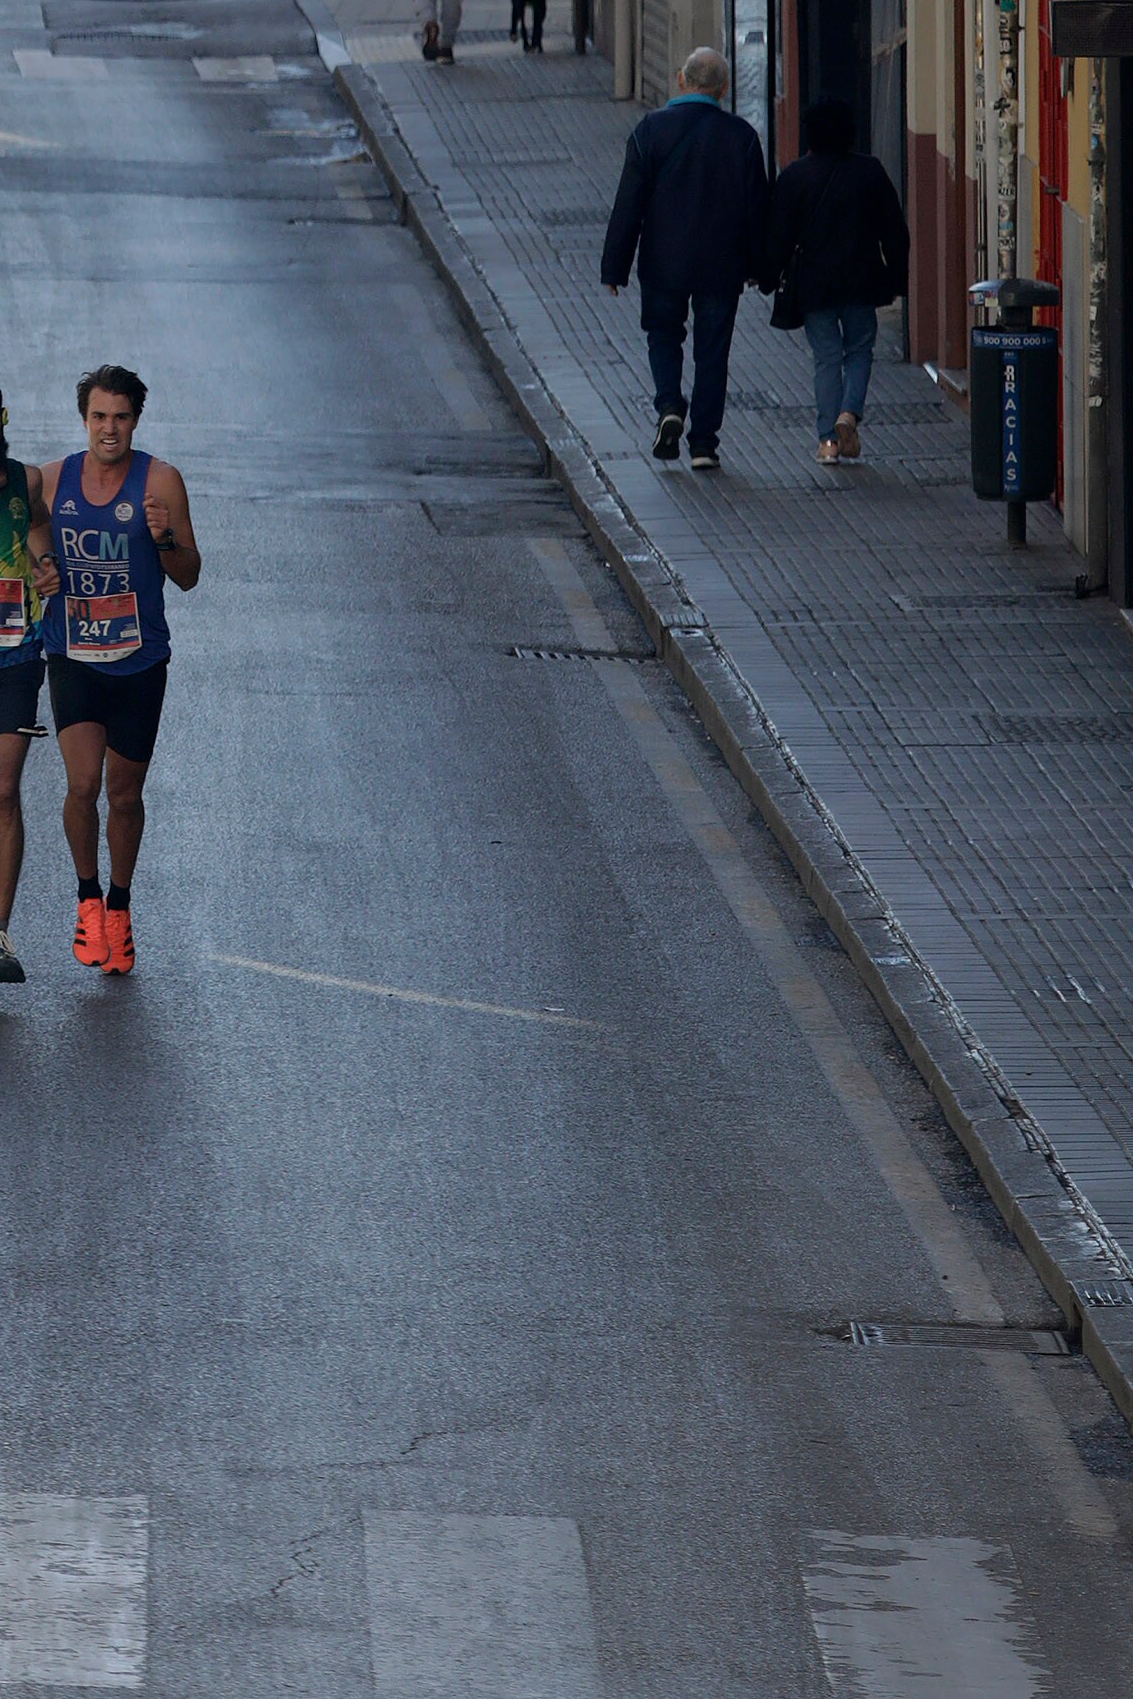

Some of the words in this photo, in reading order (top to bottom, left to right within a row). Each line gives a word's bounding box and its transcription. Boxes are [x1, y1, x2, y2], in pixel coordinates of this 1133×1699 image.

[984, 337, 1000, 345] 900
[1002, 337, 1021, 346] 900
[1023, 337, 1041, 346] 000
[61, 528, 129, 560] RCM
[67, 571, 130, 594] 1873
[78, 620, 112, 637] 247
